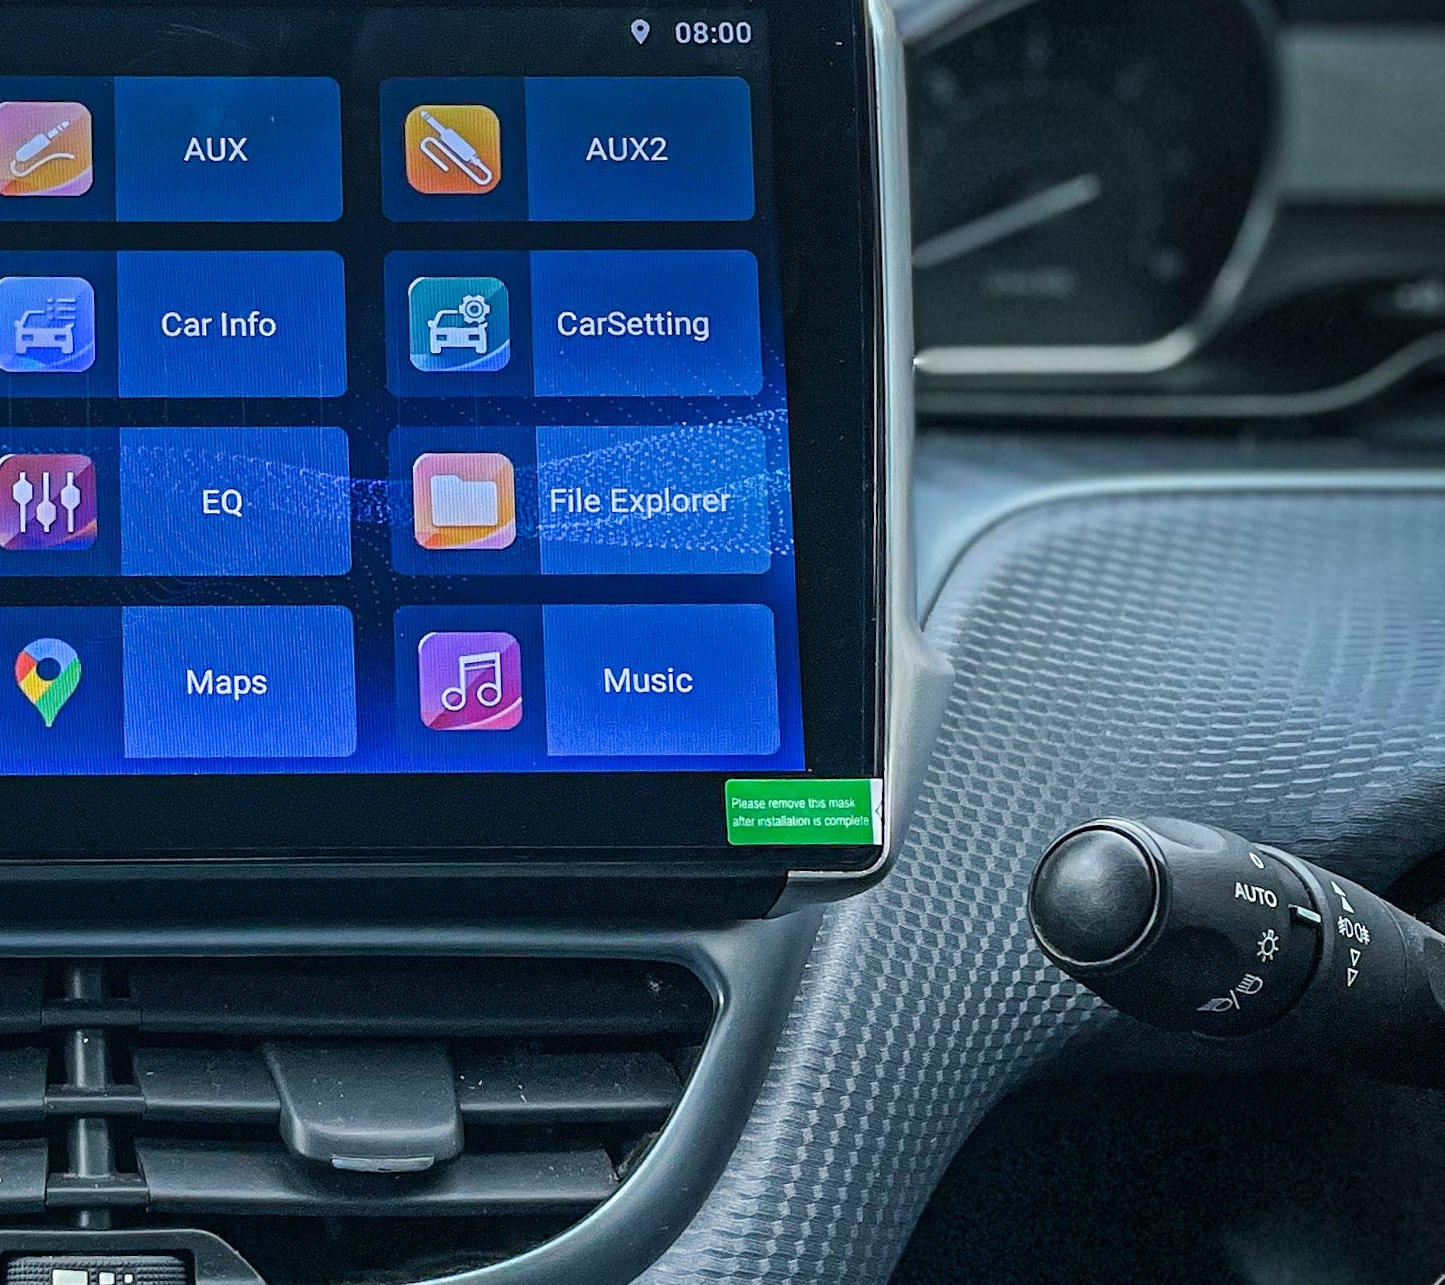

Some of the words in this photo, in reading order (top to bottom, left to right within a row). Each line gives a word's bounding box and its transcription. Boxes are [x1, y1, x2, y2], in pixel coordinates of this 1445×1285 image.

[674, 21, 753, 46] 08:00
[183, 137, 249, 164] AUX
[585, 136, 669, 164] AUX2
[160, 311, 213, 339] Car
[220, 310, 277, 338] Info
[556, 311, 711, 344] CarSetting
[201, 489, 245, 519] EQ
[550, 486, 604, 515] File
[612, 486, 732, 519] Explorer
[186, 669, 269, 700] Maps
[603, 667, 695, 695] Music
[731, 797, 766, 810] Please
[768, 798, 805, 809] remove
[808, 797, 826, 809] this
[828, 797, 855, 809] mask
[732, 815, 755, 828] after
[758, 815, 811, 827] installation
[813, 815, 822, 827] is
[824, 815, 870, 829] complete
[1235, 882, 1278, 908] AUTO
